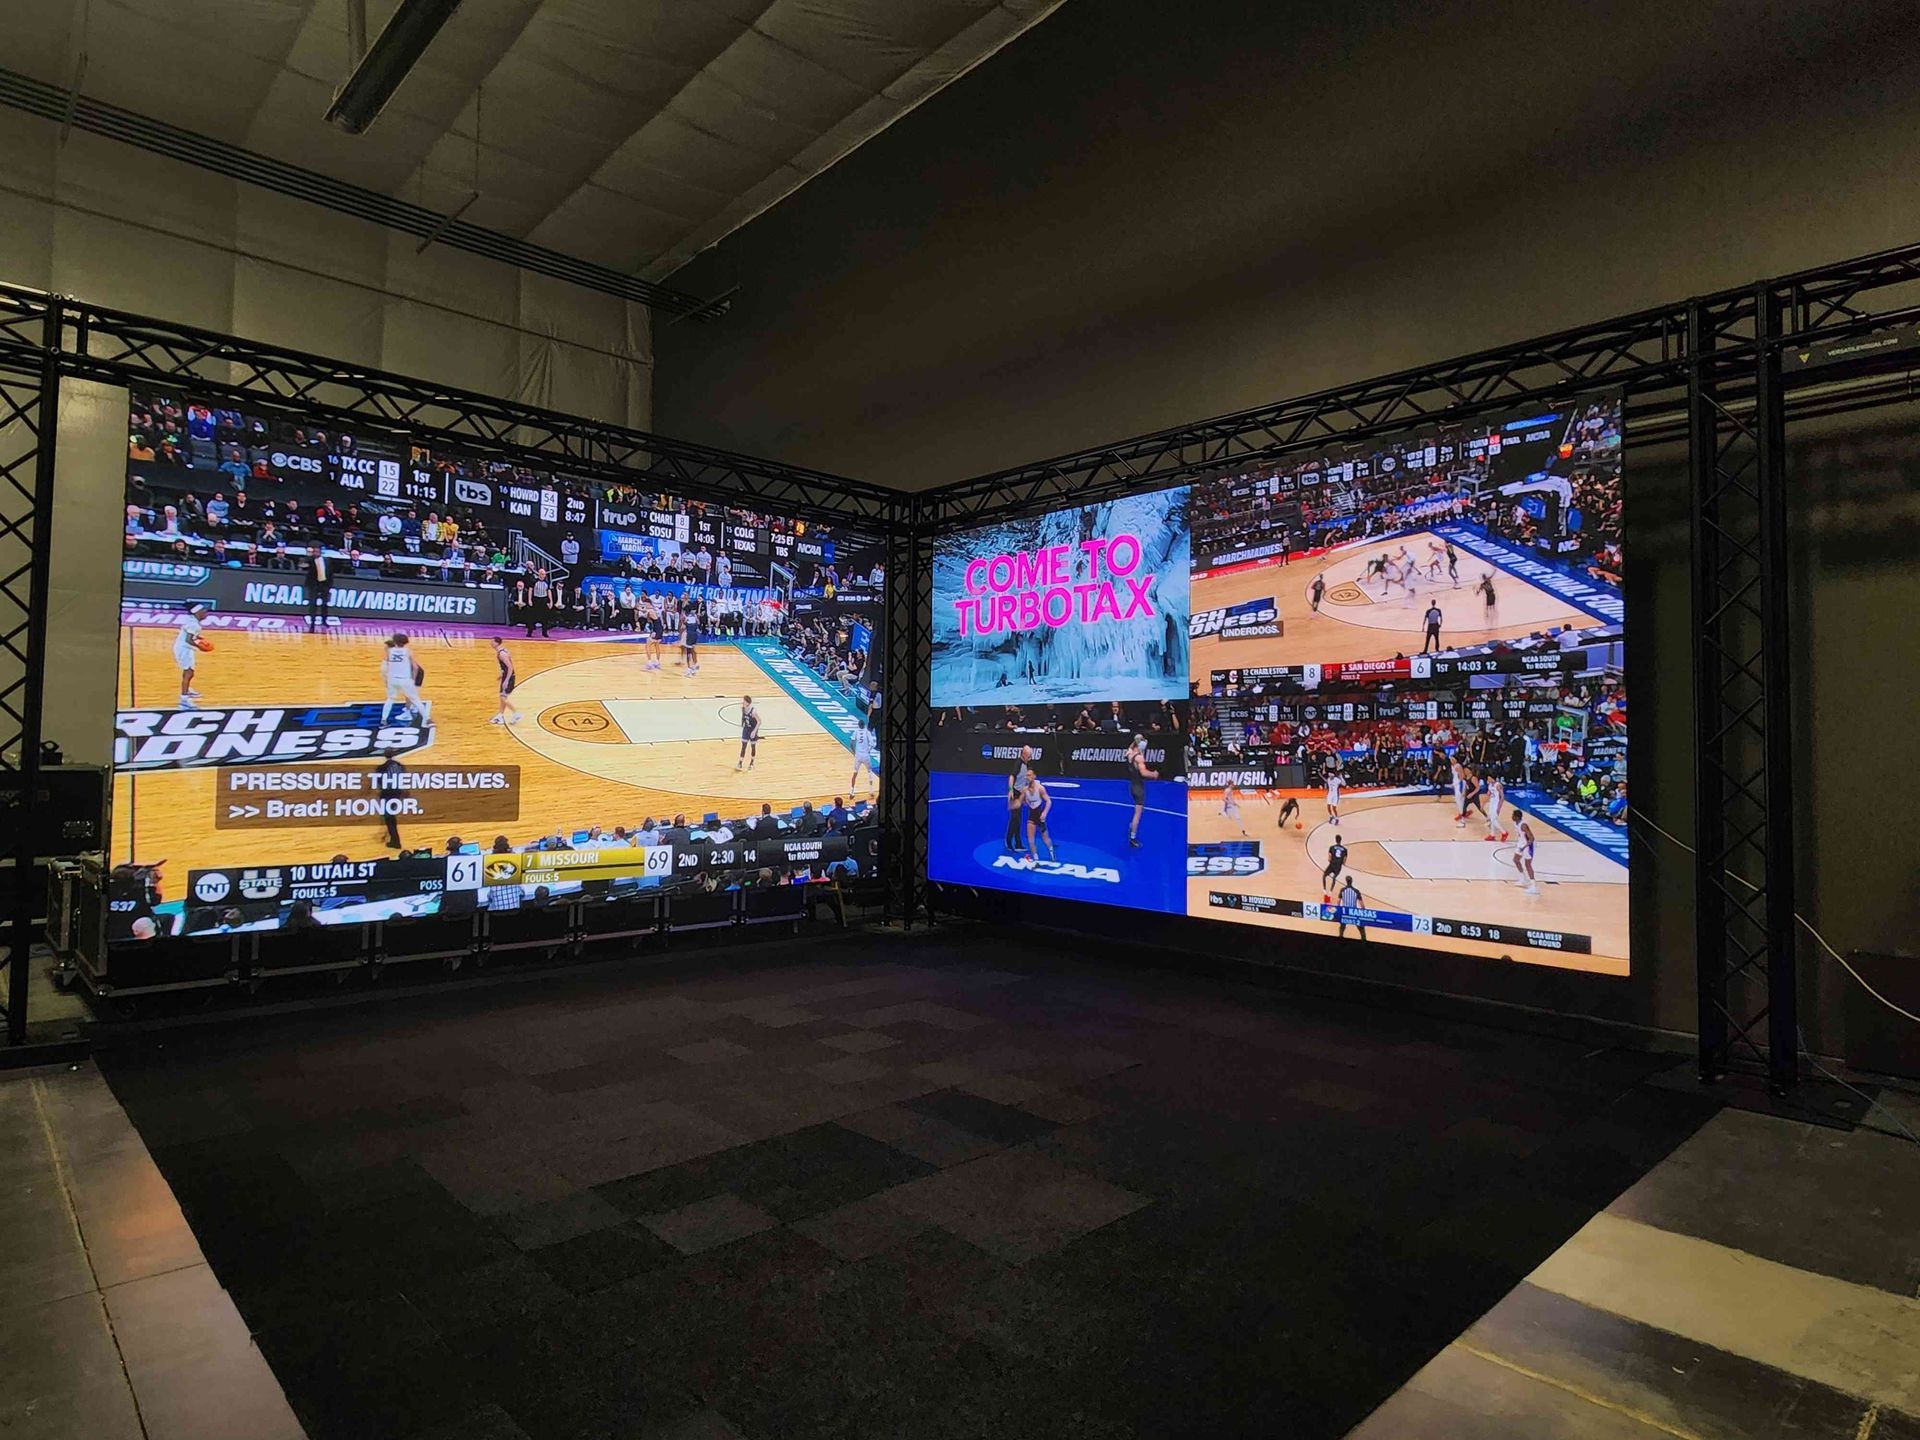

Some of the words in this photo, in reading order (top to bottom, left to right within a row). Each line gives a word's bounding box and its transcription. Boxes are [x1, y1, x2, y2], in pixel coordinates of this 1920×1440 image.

[287, 455, 322, 473] CBS
[341, 456, 358, 471] TX
[358, 459, 376, 475] CC
[383, 464, 396, 475] 15
[340, 473, 365, 489] ALA
[413, 469, 431, 483] 1ST
[382, 480, 395, 492] 22
[405, 483, 437, 499] 11:15
[459, 483, 488, 501] tbs
[510, 486, 539, 503] HOWRD
[543, 492, 555, 503] 54
[510, 502, 532, 516] KAN
[566, 497, 585, 510] 2ND
[543, 506, 555, 518] 73
[565, 510, 586, 524] 8:47
[649, 512, 674, 526] CHARL
[698, 520, 711, 532] 1ST
[649, 526, 672, 539] SDSU
[693, 532, 715, 545] 14:05
[734, 526, 755, 539] COLG
[770, 532, 786, 544] 7:25
[786, 536, 795, 546] ET
[733, 539, 756, 552] TEXAS
[775, 546, 789, 557] TBS
[797, 543, 822, 556] NCAA
[964, 546, 1071, 595] COME
[1080, 534, 1141, 580] TO
[955, 575, 1155, 636] TURBOTAX
[1250, 667, 1289, 676] CHARLESTON
[1348, 663, 1362, 671] SAN
[1363, 661, 1384, 671] DIEGO
[1386, 661, 1396, 669] ST
[1417, 662, 1424, 673] 6
[1436, 663, 1449, 673] 1ST
[1456, 662, 1481, 672] 14:03
[1486, 661, 1497, 671] 12
[1309, 668, 1315, 678] 8
[1472, 702, 1486, 710] AUB
[566, 716, 594, 728] 14
[230, 772, 362, 791] PRESSURE
[367, 772, 510, 790] THEMSELVES.
[266, 799, 329, 818] Brad:
[335, 798, 424, 816] HONOR.
[784, 842, 801, 852] NCAA
[801, 841, 823, 850] SOUTH
[526, 854, 533, 867] 7
[539, 853, 599, 867] MISSOURI
[647, 850, 668, 870] 69
[678, 853, 698, 867] 2ND
[710, 850, 735, 865] 2:30
[743, 850, 756, 863] 14
[796, 852, 819, 861] ROUND
[290, 867, 306, 881] 10
[311, 864, 354, 880] UTAH
[358, 863, 377, 876] ST
[452, 861, 477, 882] 61
[993, 855, 1121, 883] NCAA
[238, 878, 284, 891] STATE
[420, 879, 443, 890] POSS
[525, 873, 559, 884] FOULS:5
[197, 883, 229, 894] TNT
[292, 887, 337, 899] FOULS:5
[1210, 895, 1223, 905] tbs
[1248, 896, 1277, 906] HOWARD
[1305, 905, 1318, 916] 54
[1348, 908, 1377, 918] KANSAS
[1415, 919, 1429, 931] 73
[1436, 922, 1452, 934] 2ND
[1460, 925, 1481, 937] 8:53
[1488, 929, 1500, 939] 18
[1538, 939, 1561, 948] ROUND
